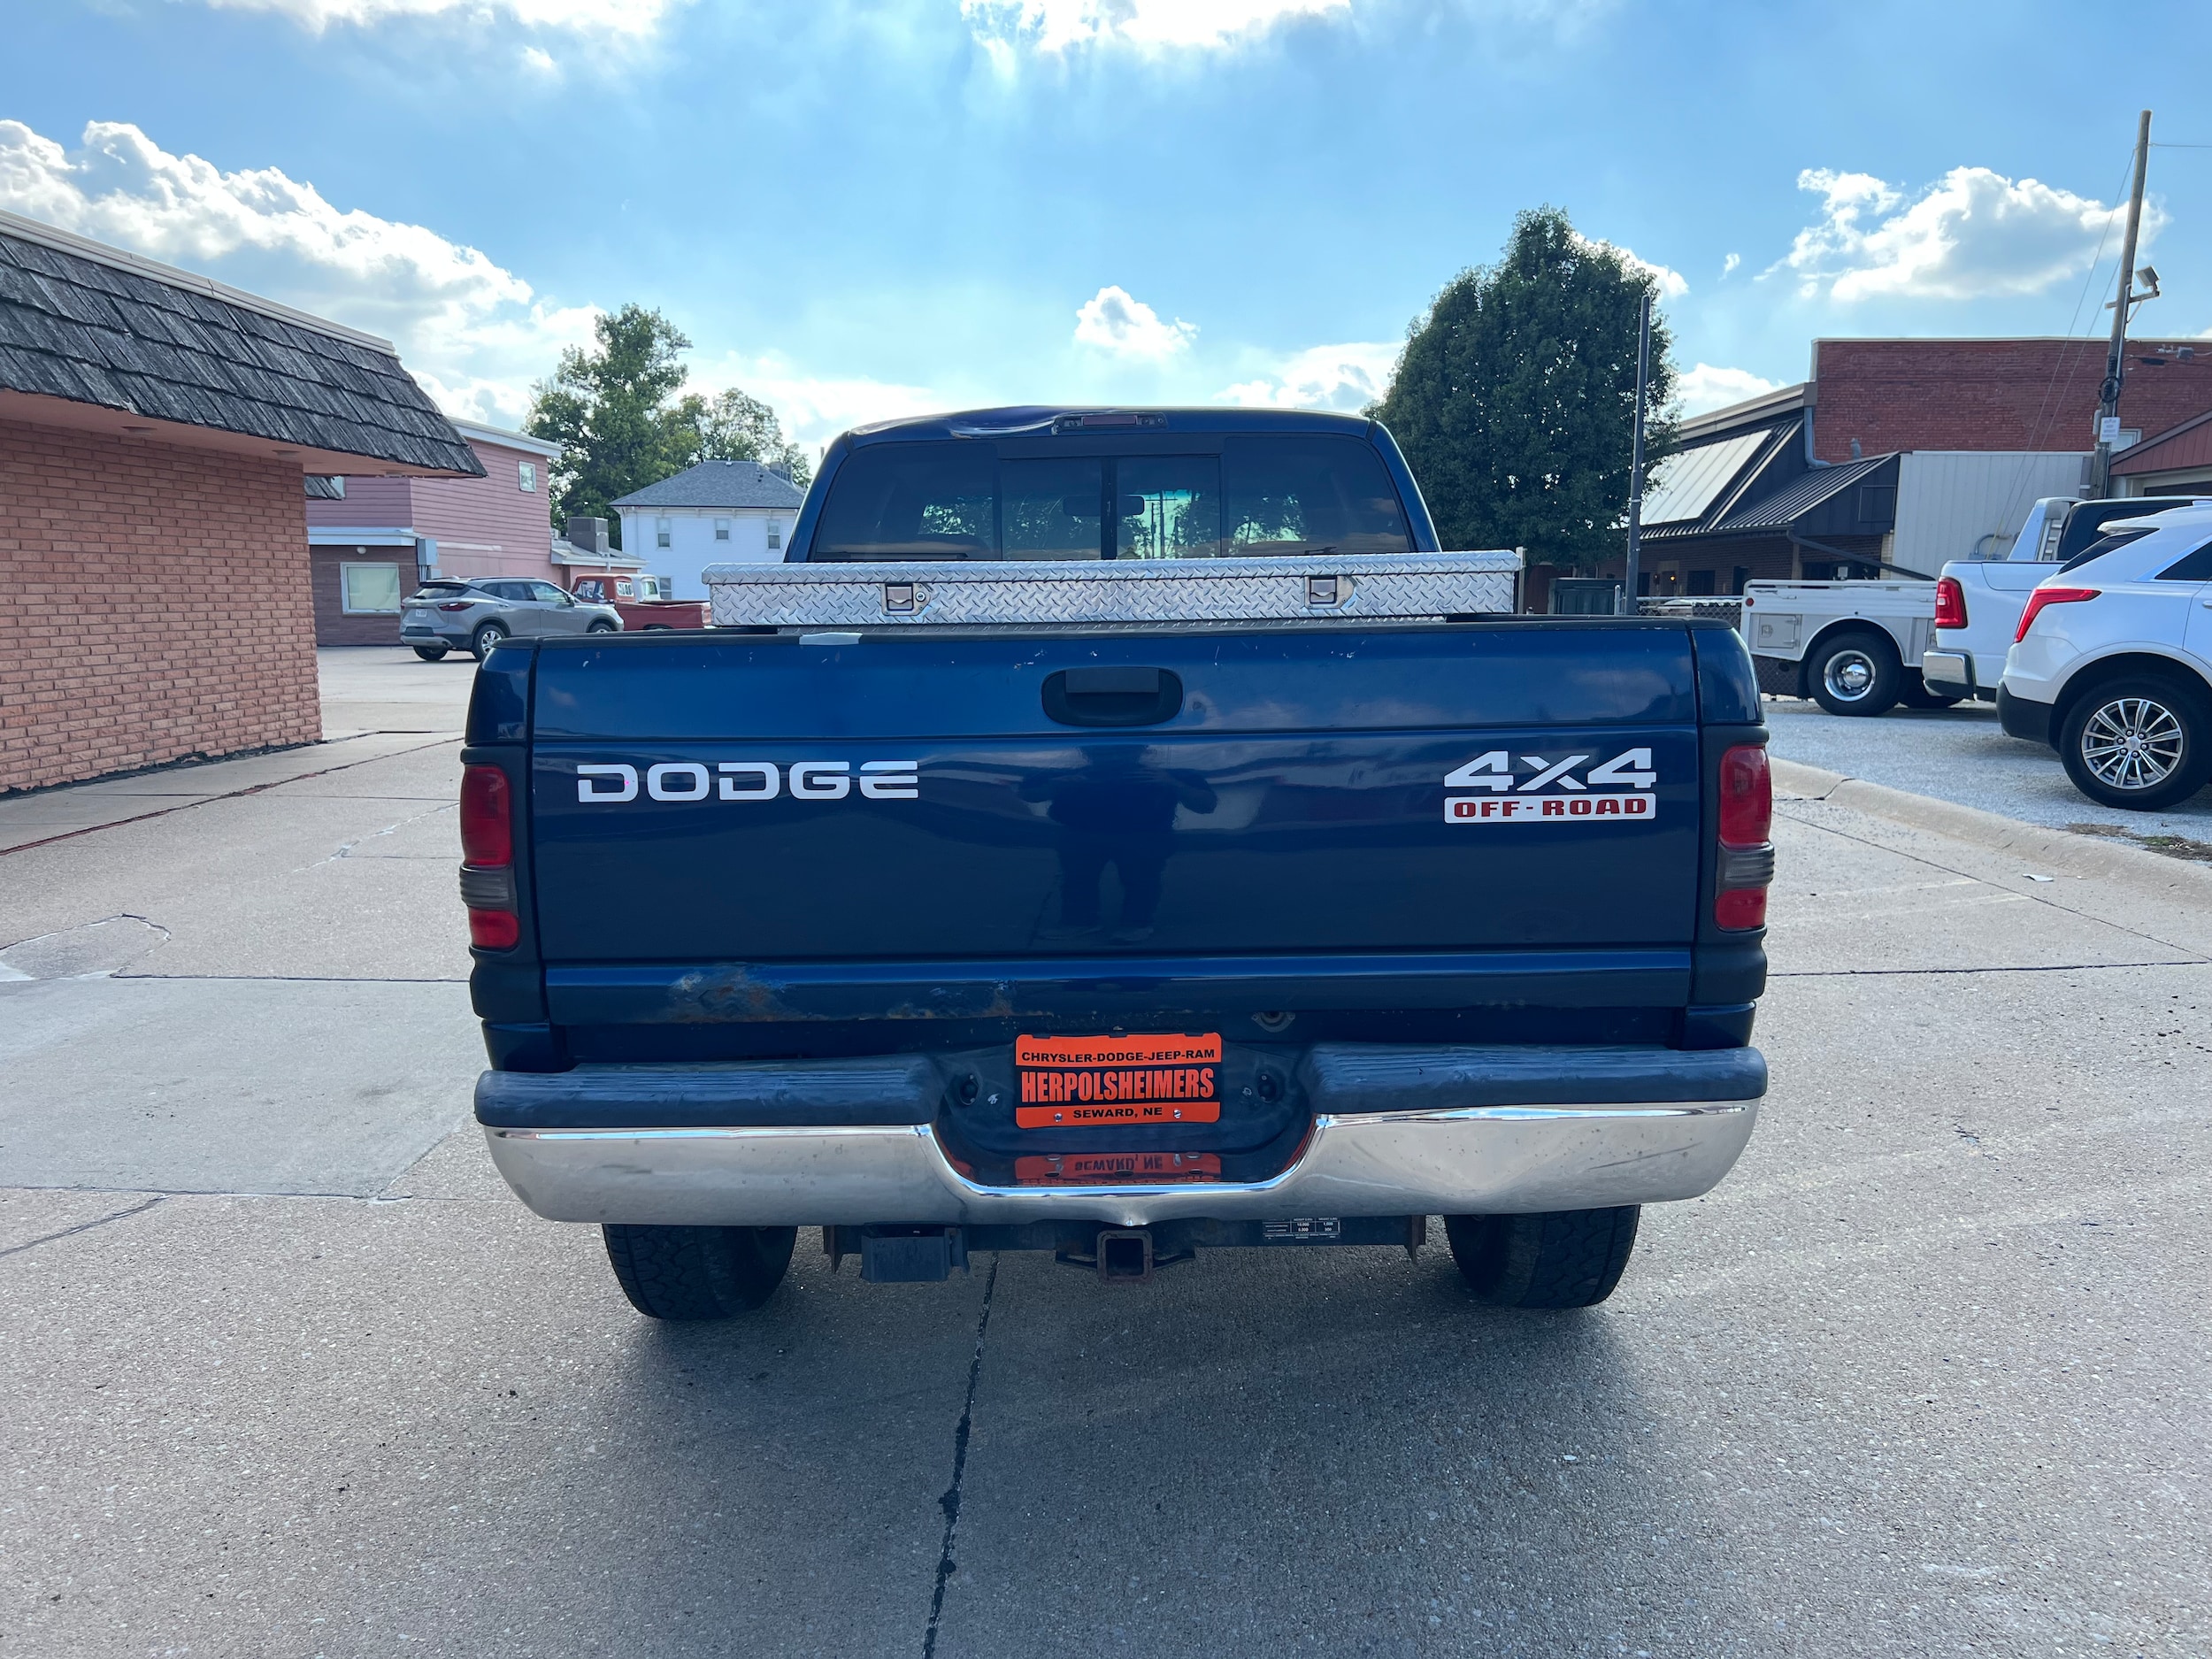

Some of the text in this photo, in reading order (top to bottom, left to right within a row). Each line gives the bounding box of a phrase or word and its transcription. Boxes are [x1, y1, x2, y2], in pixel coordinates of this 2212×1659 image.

[577, 760, 919, 803] DODGE
[1021, 1048, 1215, 1064] CHRYSLER-DODGE-JEEP-RAM
[1021, 1067, 1215, 1102] HERPOLSHEIMERS
[1073, 1107, 1163, 1118] SEWARD, NE
